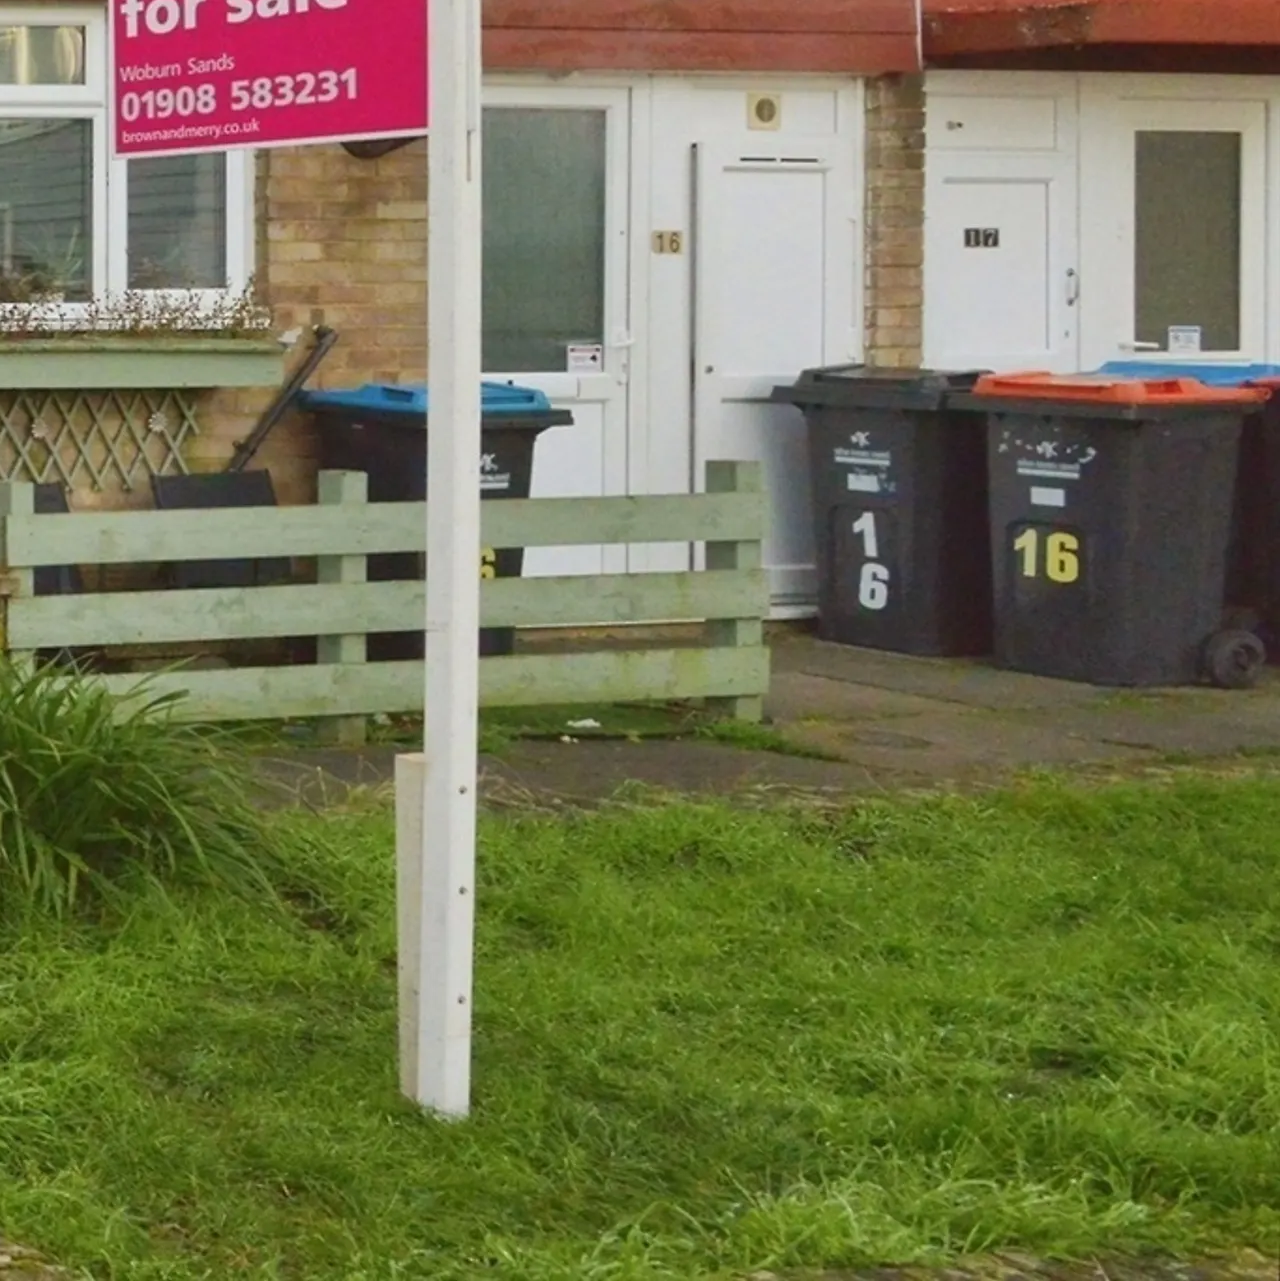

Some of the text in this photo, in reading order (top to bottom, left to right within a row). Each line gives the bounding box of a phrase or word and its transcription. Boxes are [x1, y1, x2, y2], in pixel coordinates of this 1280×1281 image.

[119, 53, 236, 82] Woburn Sands
[121, 68, 358, 122] 01908 583231
[122, 118, 261, 144] brownandmerry.co.uk
[655, 231, 680, 254] 16
[967, 228, 997, 248] 17
[1013, 528, 1080, 584] 16
